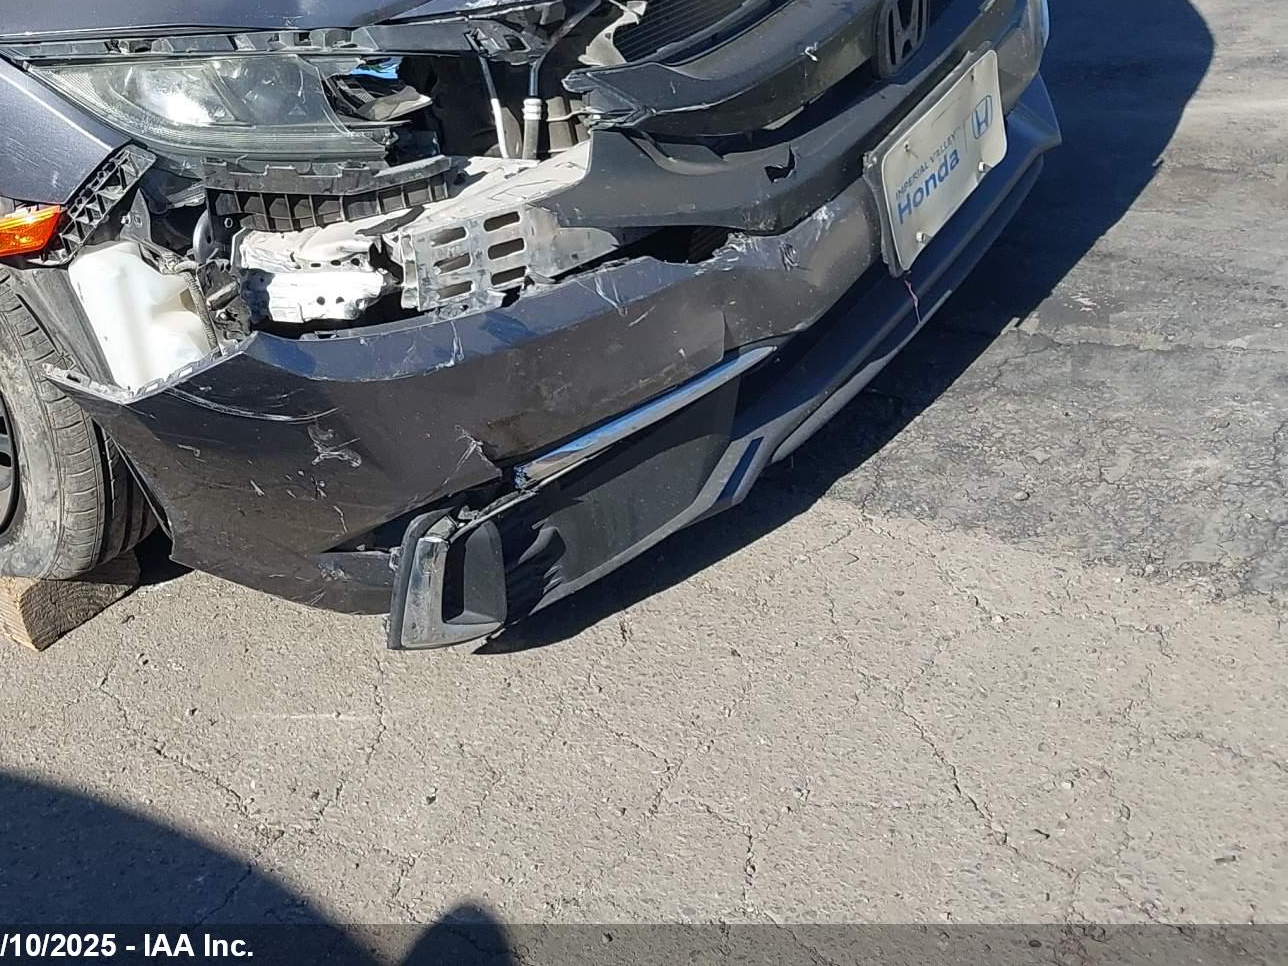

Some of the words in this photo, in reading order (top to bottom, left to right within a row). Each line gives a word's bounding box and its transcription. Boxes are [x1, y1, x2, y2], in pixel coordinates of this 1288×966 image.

[895, 161, 929, 201] IMPERIAL
[929, 130, 957, 164] VALLEY
[898, 149, 961, 226] Honda
